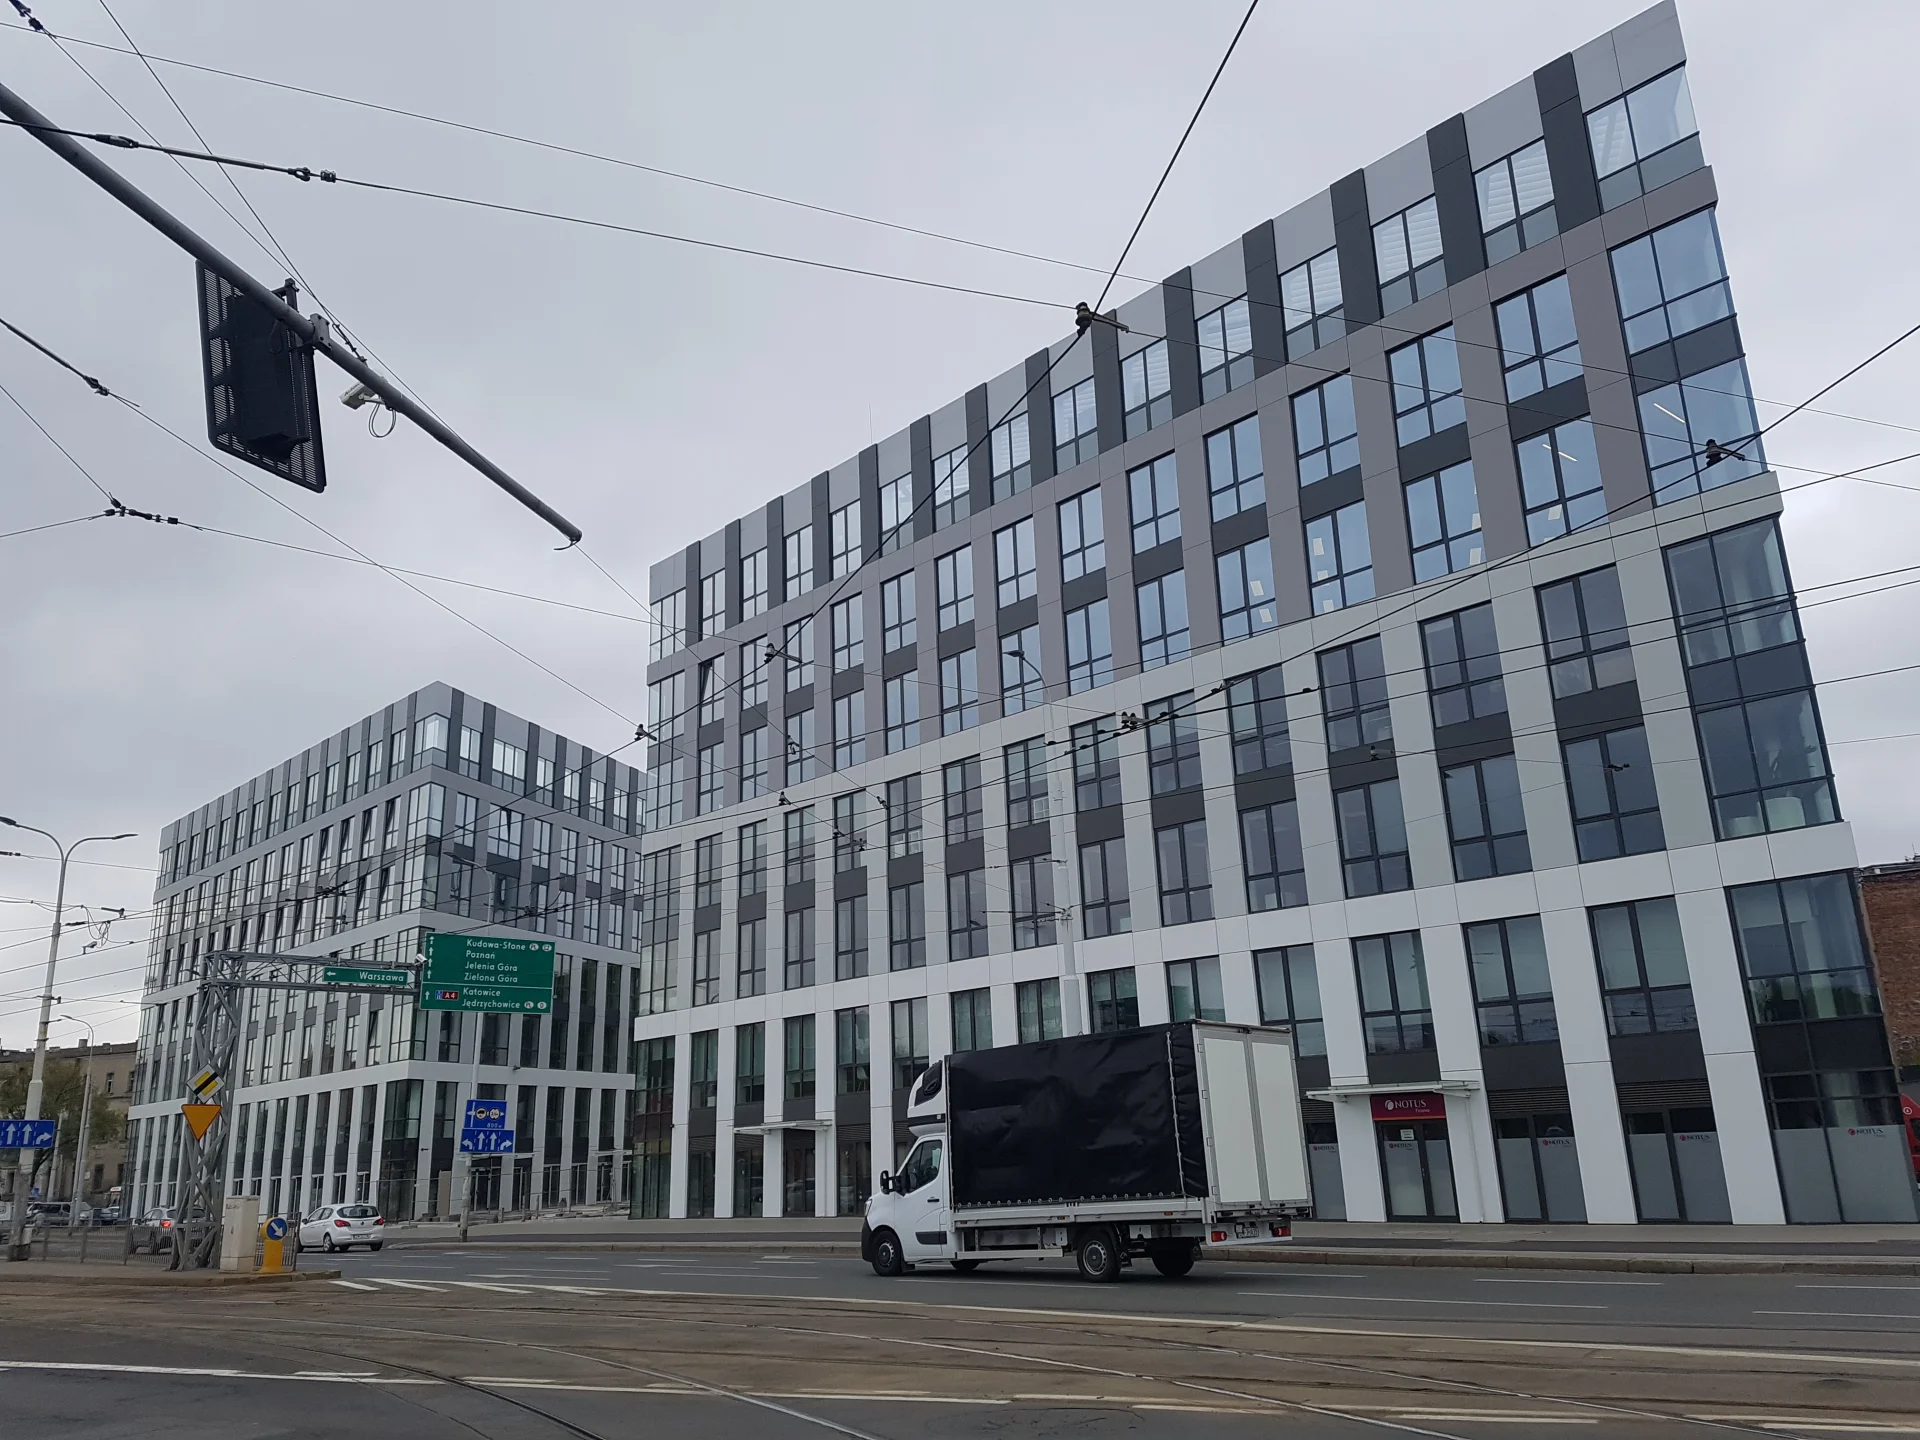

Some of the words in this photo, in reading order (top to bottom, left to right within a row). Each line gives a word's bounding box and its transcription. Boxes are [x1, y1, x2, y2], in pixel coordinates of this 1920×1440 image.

[465, 950, 496, 960] Poznań
[465, 961, 495, 971] Jelenia
[497, 963, 518, 972] Góra
[359, 971, 404, 982] Warszawa
[464, 972, 495, 982] Zielona
[497, 974, 518, 983] Góra
[463, 987, 501, 997] Katowice
[461, 999, 521, 1010] Jędrzychowice
[1394, 1099, 1427, 1109] NOTUS
